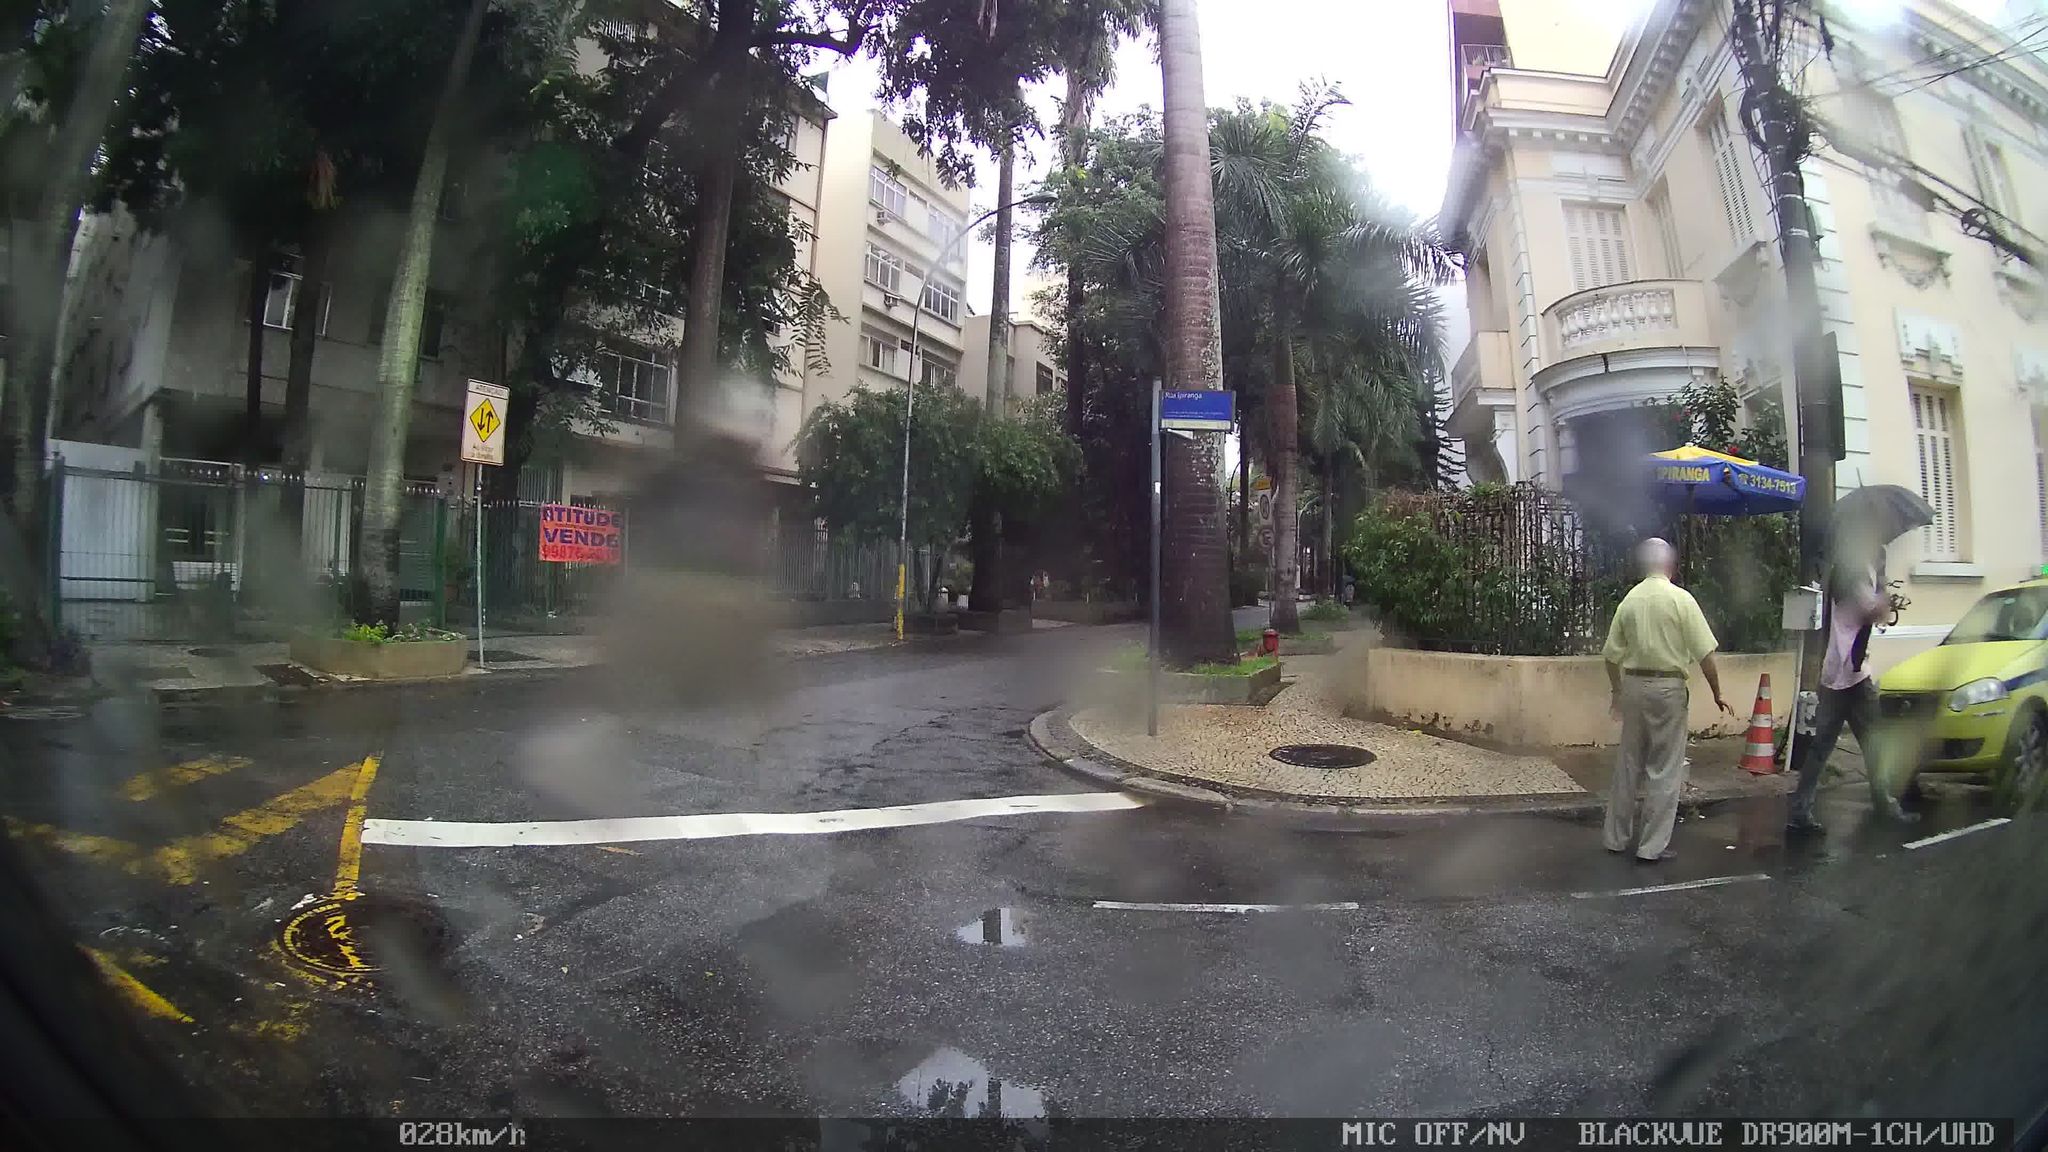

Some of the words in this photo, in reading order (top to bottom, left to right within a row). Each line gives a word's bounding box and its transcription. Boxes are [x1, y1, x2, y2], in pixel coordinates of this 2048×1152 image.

[1177, 392, 1203, 400] Ipiranga
[1657, 465, 1710, 482] PIRANGA
[542, 506, 624, 528] ATITUDE
[544, 527, 618, 548] VENDE
